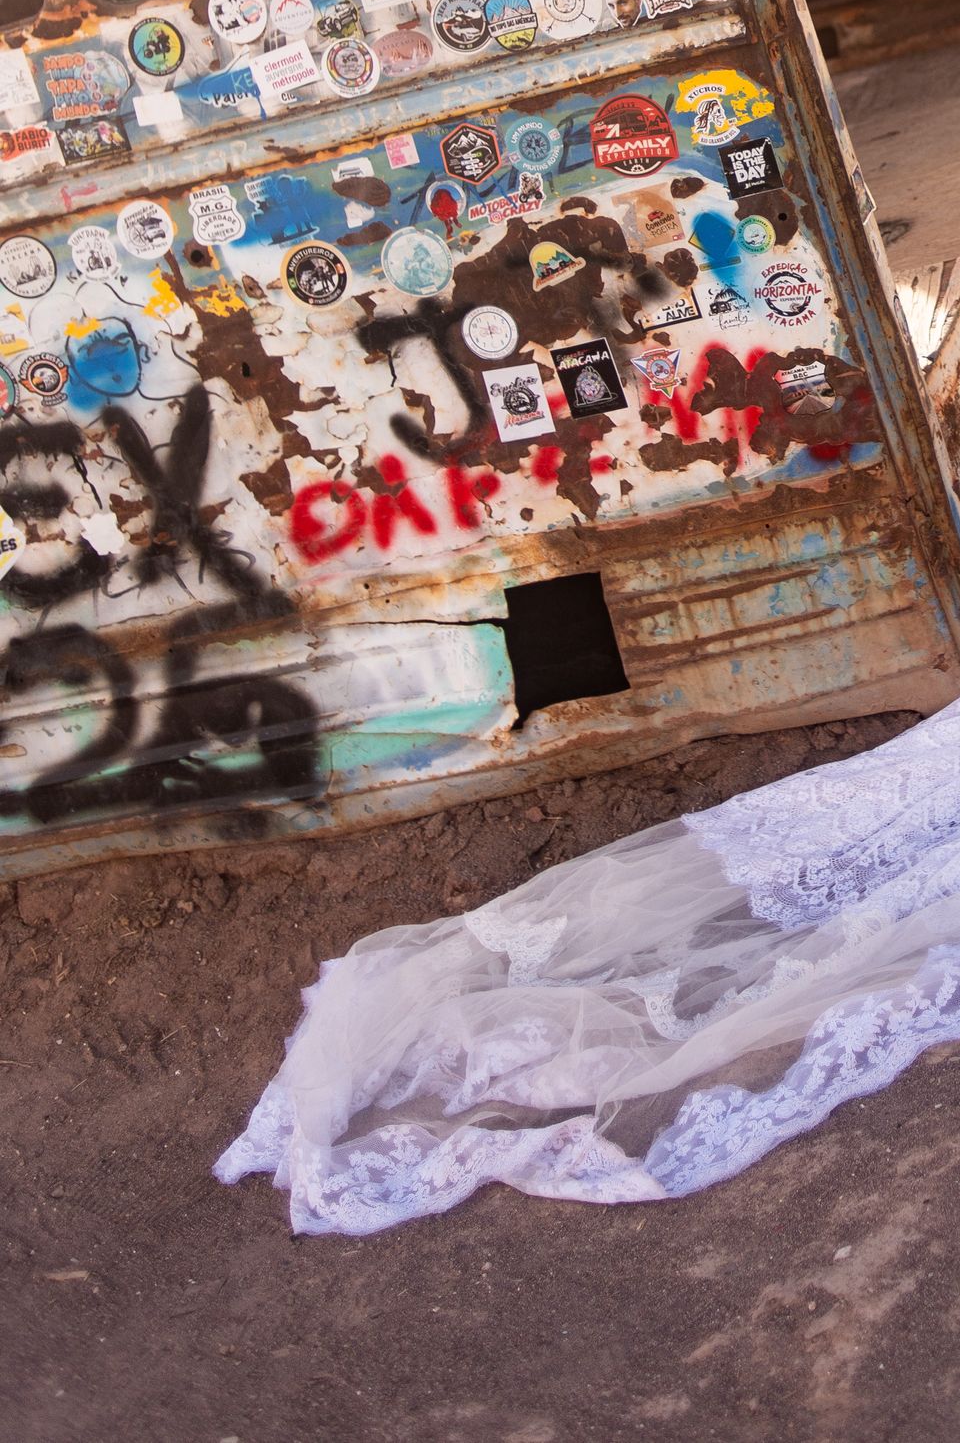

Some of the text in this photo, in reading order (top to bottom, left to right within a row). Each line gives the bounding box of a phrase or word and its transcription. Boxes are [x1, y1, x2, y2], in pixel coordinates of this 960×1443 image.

[274, 9, 312, 23] ADVENTURE
[264, 51, 304, 73] clermont
[265, 62, 305, 82] auvergne
[271, 67, 316, 91] métropole
[687, 85, 723, 101] XUCROS
[15, 128, 48, 142] FABIO
[518, 122, 543, 135] MUNDO
[597, 136, 671, 156] FAMILY
[727, 145, 765, 162] TODAY
[599, 148, 670, 163] EXPEDITION
[623, 158, 650, 166] EARTH
[732, 156, 766, 171] IS THE
[522, 162, 548, 172] MUITAS
[734, 164, 767, 183] DAY
[192, 187, 226, 200] BRASIL
[200, 201, 228, 214] M.G.
[469, 192, 542, 220] MOTOBOY CRAZY
[201, 215, 236, 233] LIBERDADE
[645, 212, 675, 231] Comendo
[651, 222, 679, 238] POEIRA
[288, 246, 335, 272] AVENTUREIROS
[760, 262, 809, 279] EXPEDIÇÃO
[754, 281, 823, 300] HORIZONTAL
[665, 306, 697, 323] ALIVE
[765, 308, 817, 328] ATACAMA
[557, 350, 610, 370] ATACAMA
[781, 367, 805, 376] ATACAMA
